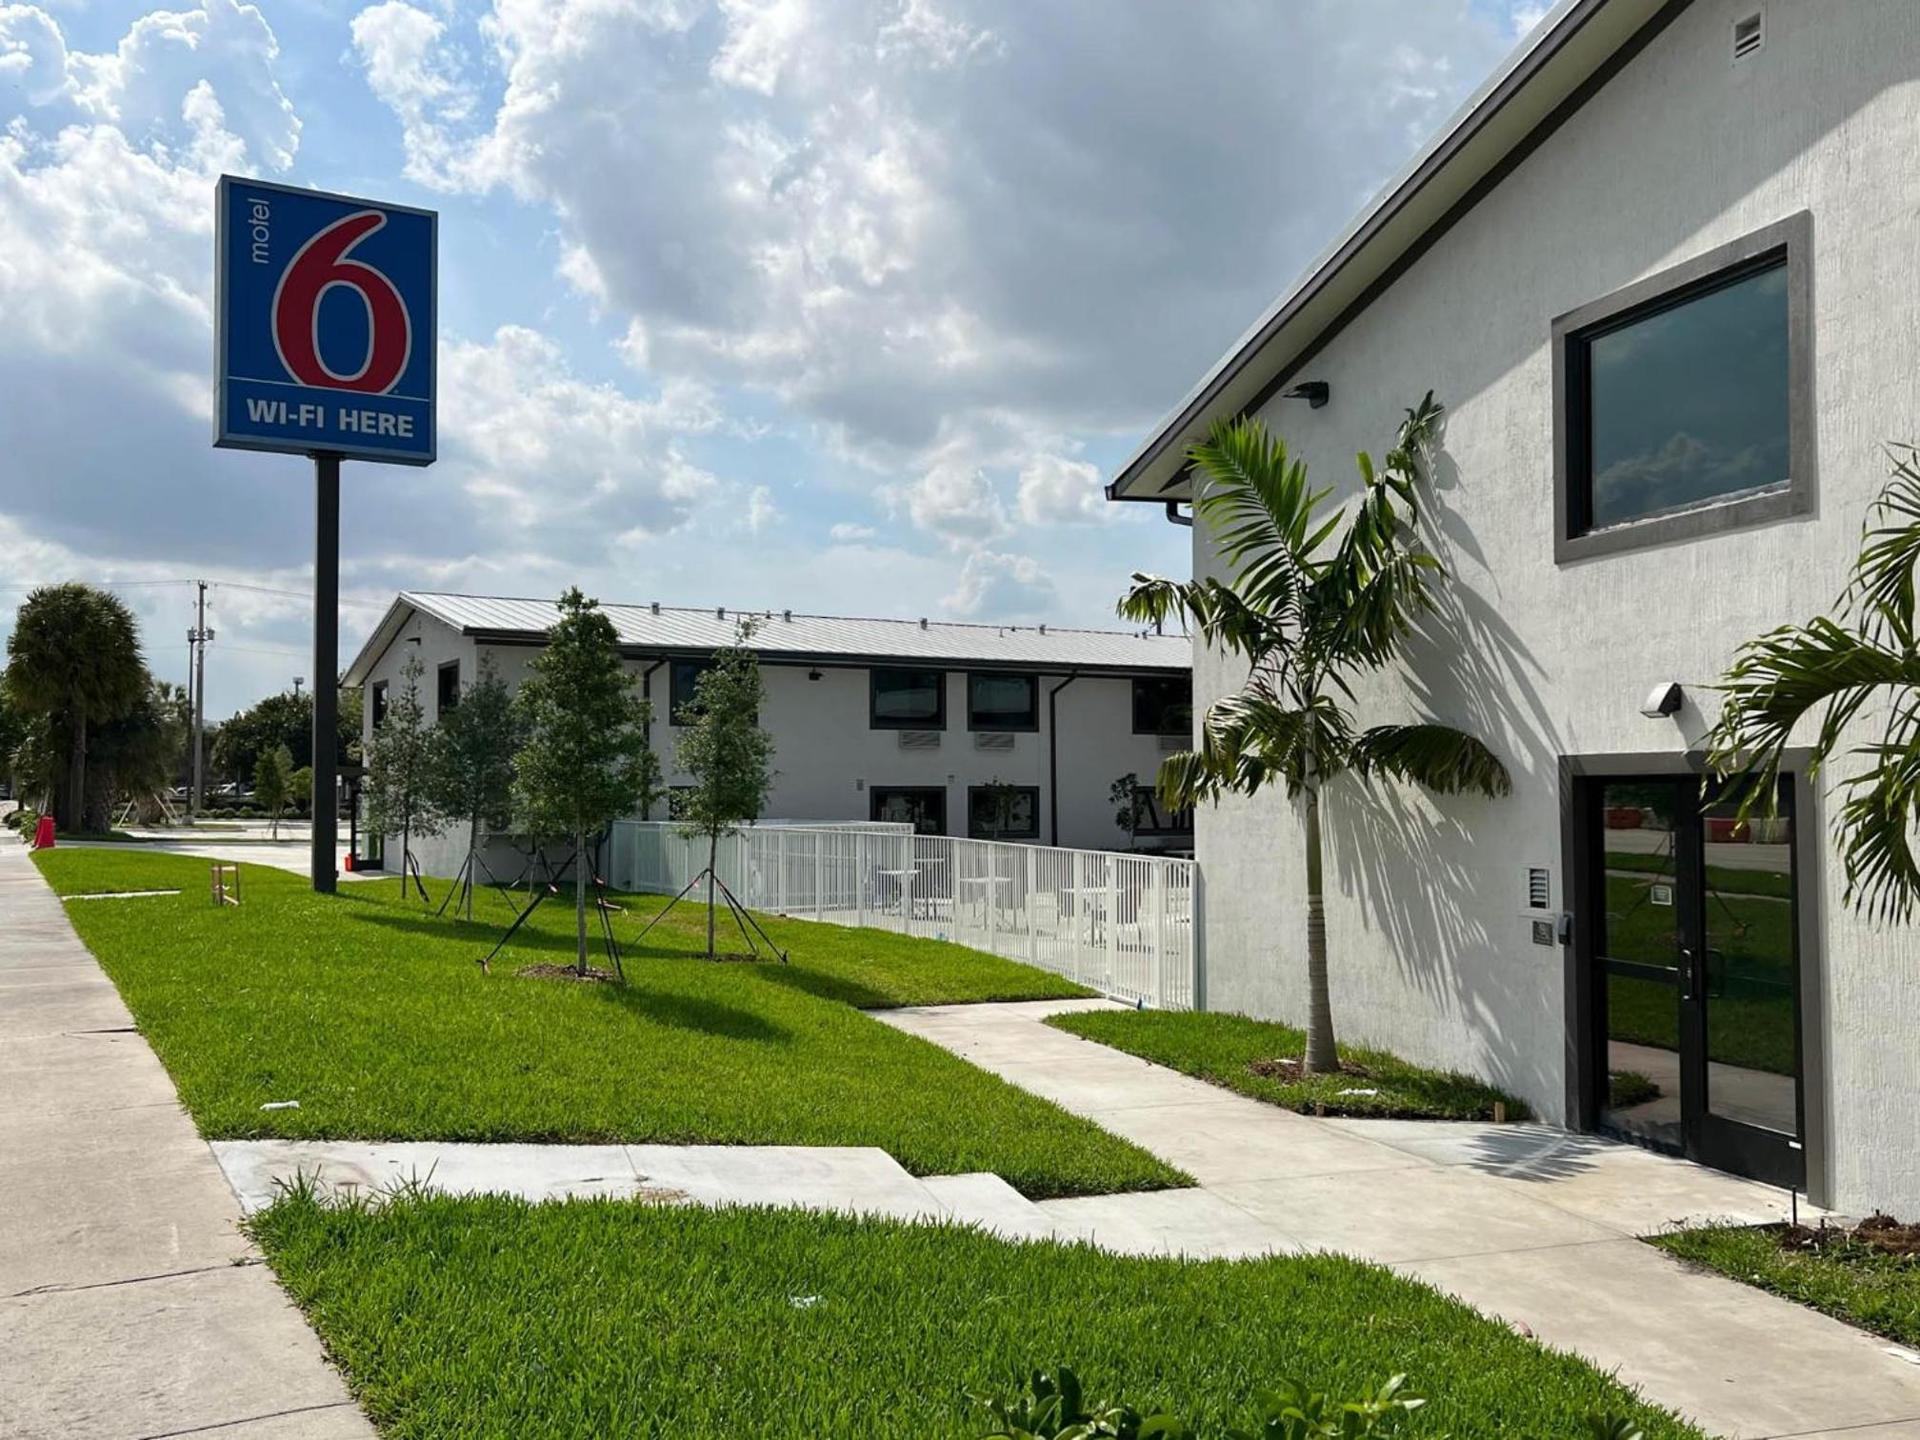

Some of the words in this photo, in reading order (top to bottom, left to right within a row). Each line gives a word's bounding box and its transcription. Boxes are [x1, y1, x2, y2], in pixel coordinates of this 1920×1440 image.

[248, 198, 270, 264] motel
[271, 209, 412, 396] 6
[247, 398, 324, 428] WI-FI
[339, 408, 414, 438] HERE
